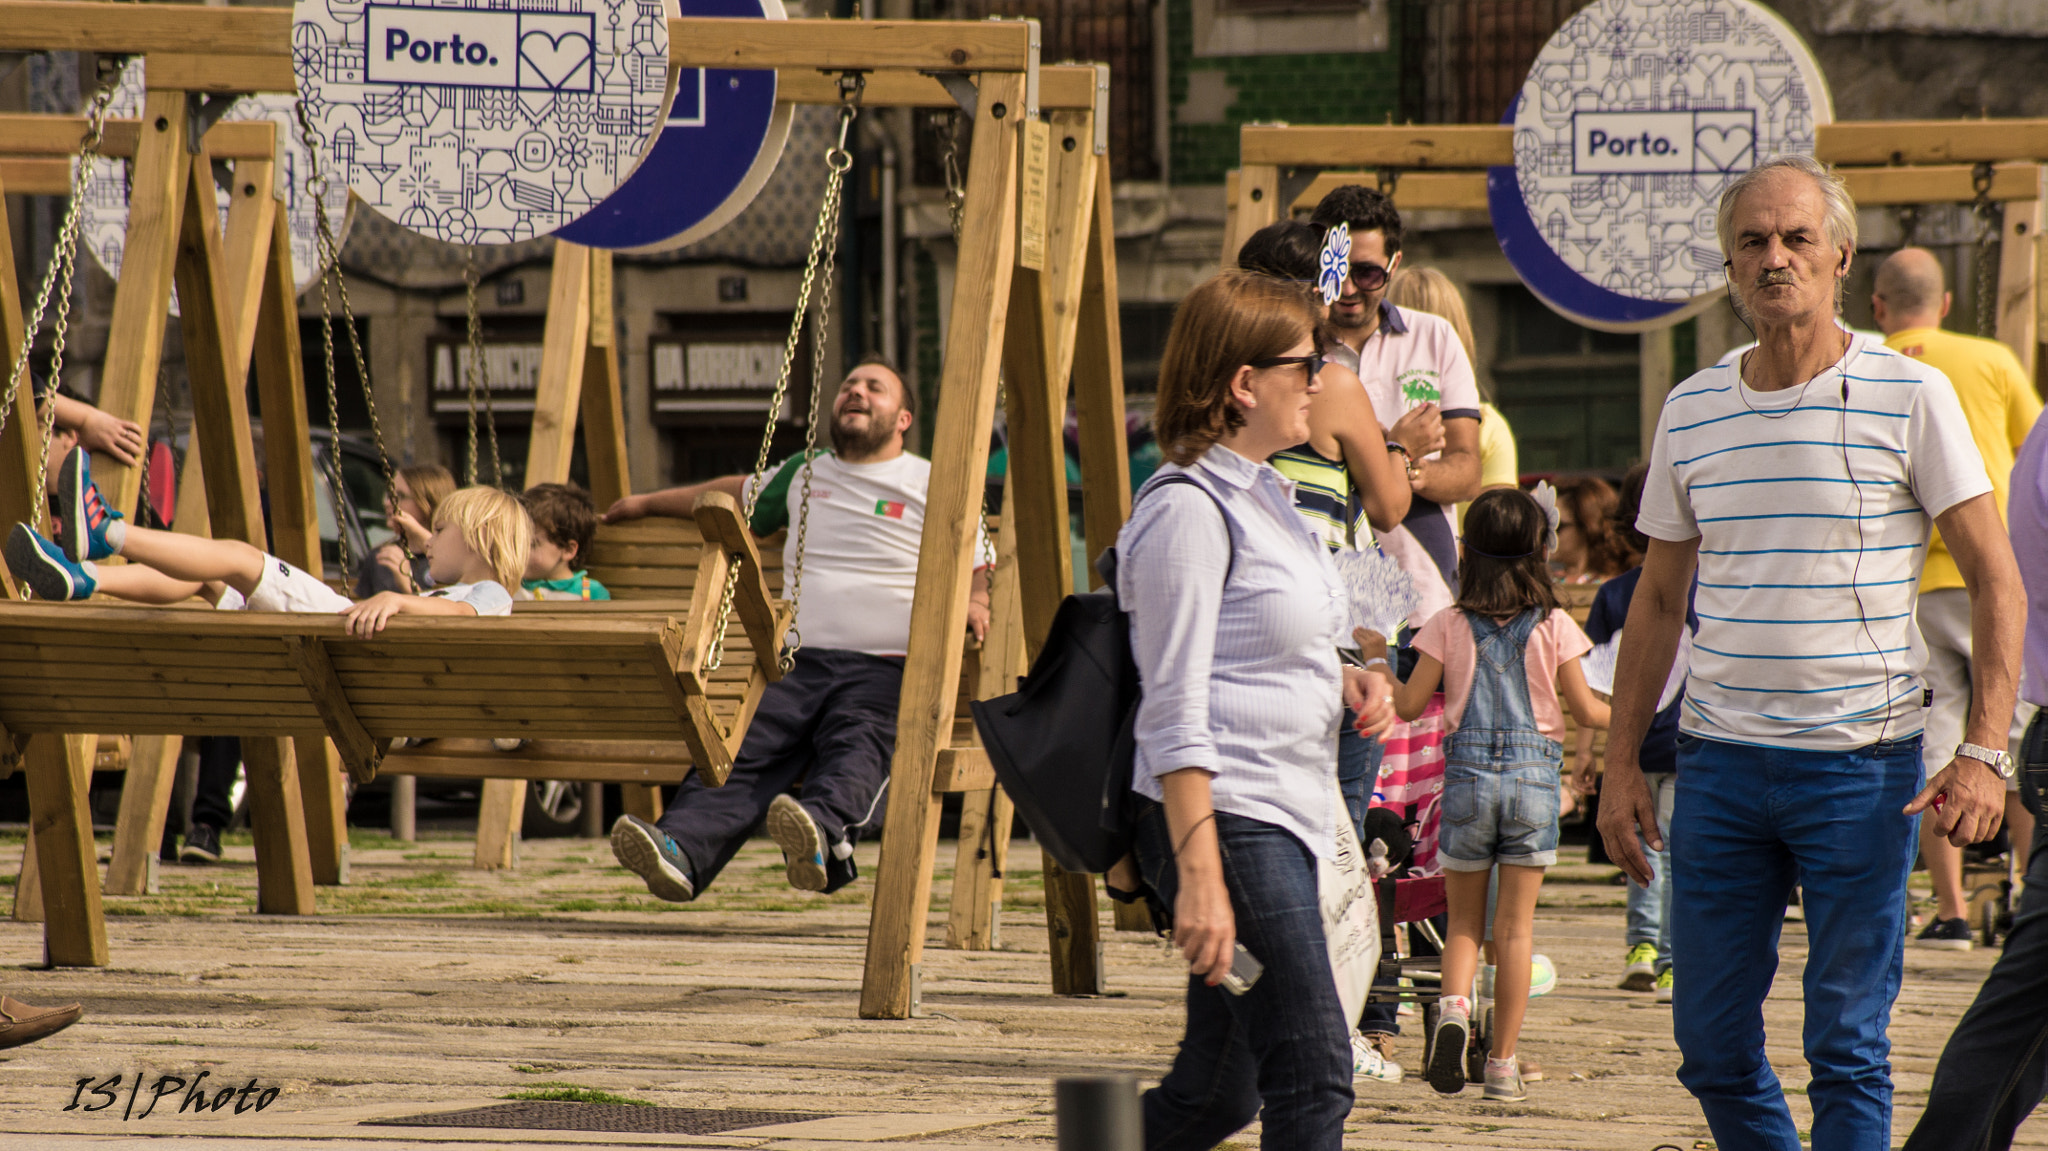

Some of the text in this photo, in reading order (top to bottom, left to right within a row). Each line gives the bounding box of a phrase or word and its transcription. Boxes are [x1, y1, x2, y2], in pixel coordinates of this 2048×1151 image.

[386, 28, 498, 67] Porto.
[1589, 130, 1678, 156] Porto.
[434, 344, 454, 391] A
